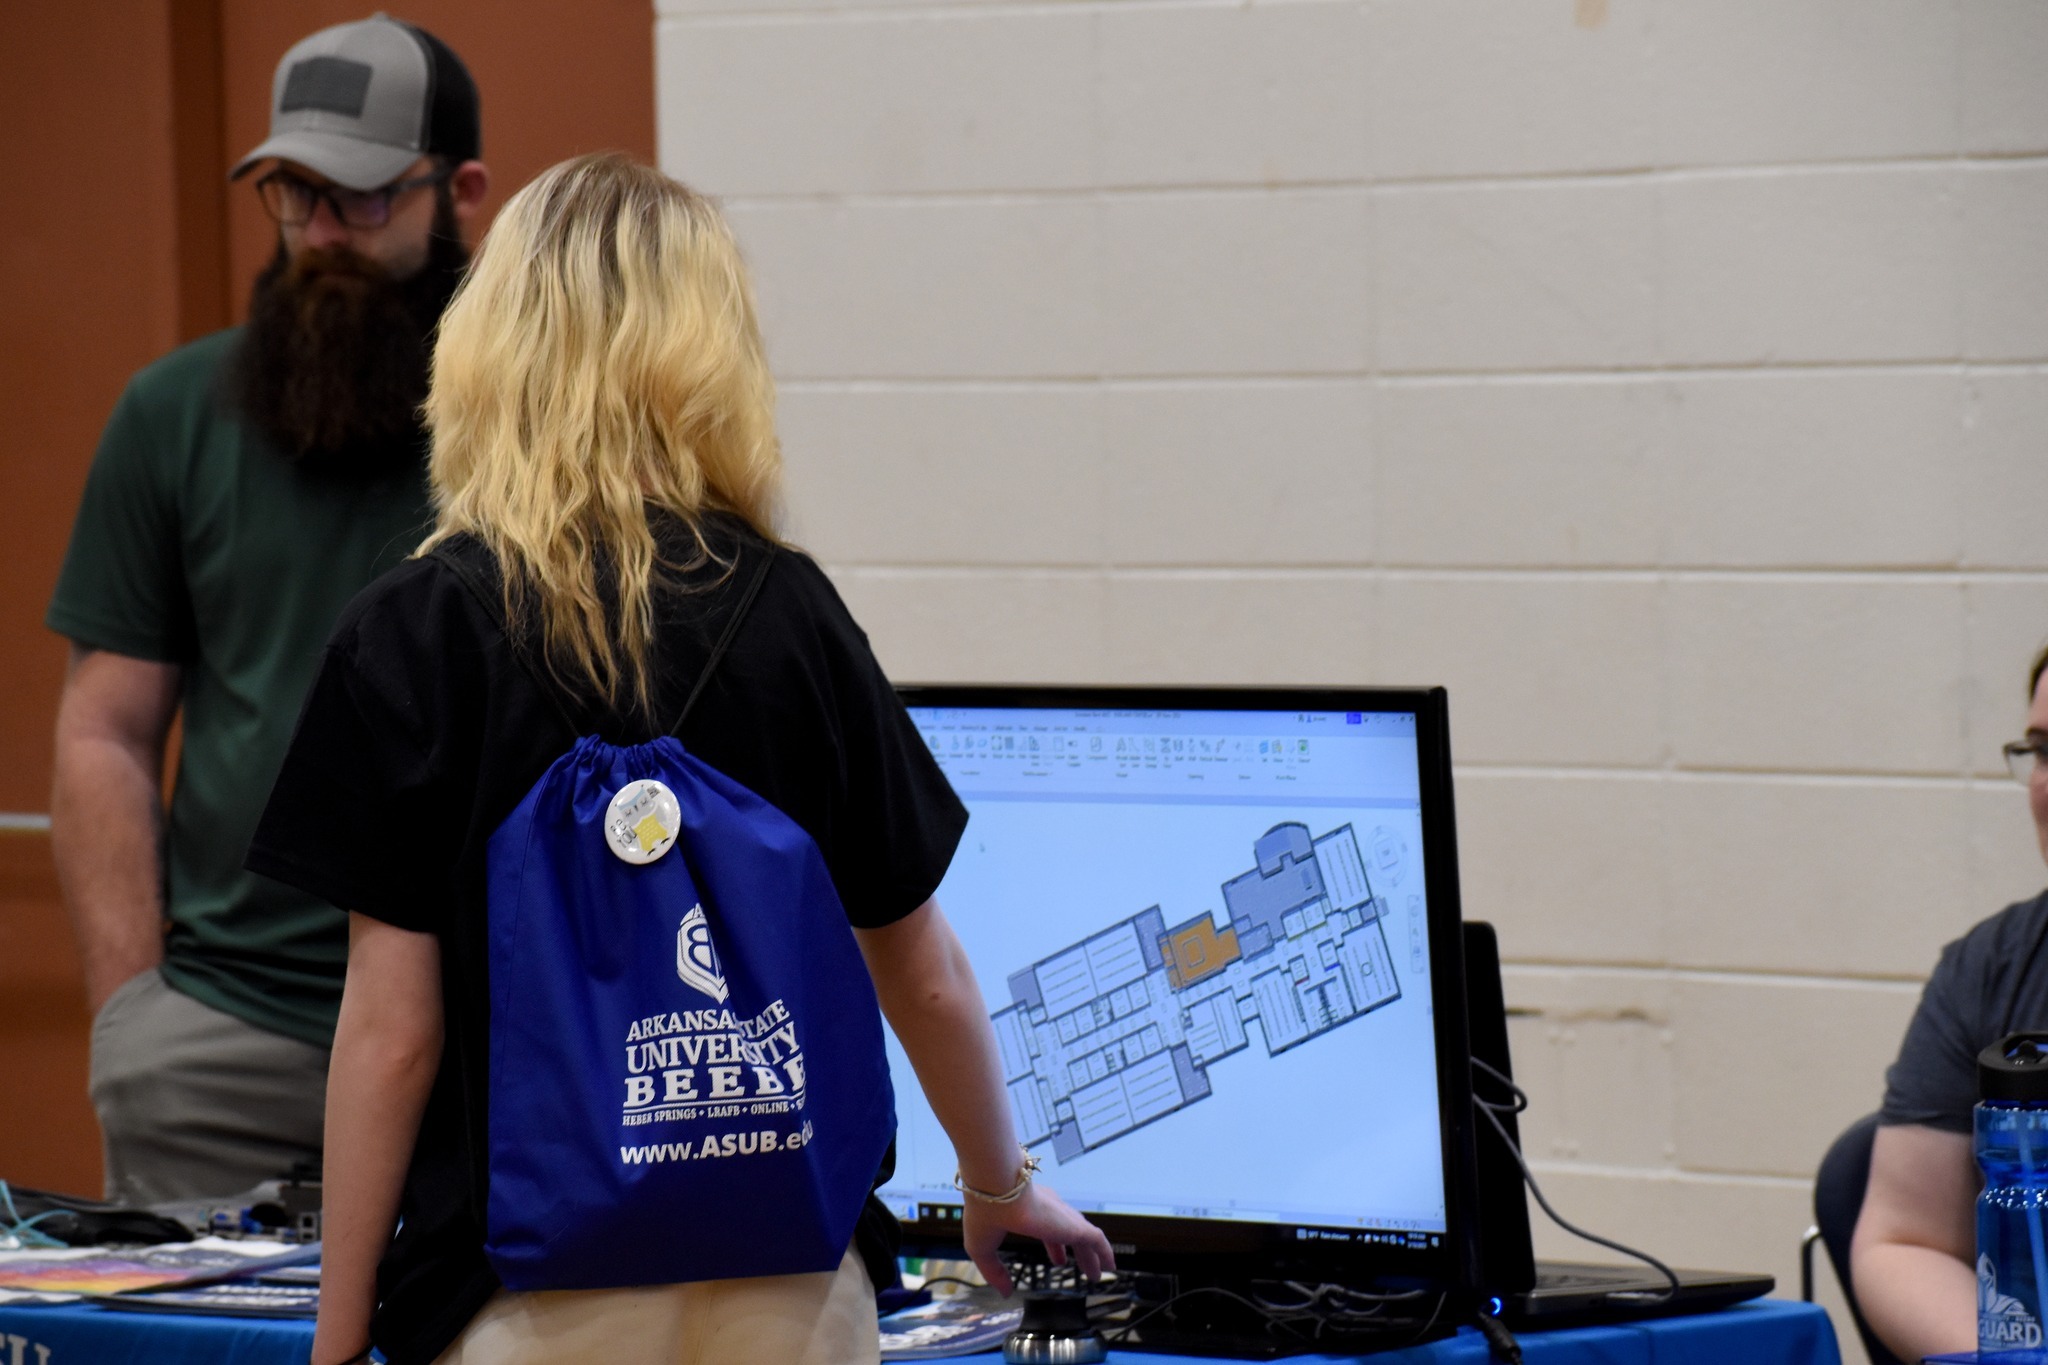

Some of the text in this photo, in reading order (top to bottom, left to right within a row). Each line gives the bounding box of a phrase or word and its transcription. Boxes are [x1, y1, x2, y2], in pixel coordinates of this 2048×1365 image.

[626, 1009, 740, 1043] ARKANSA
[622, 1112, 652, 1126] HEBER
[654, 1107, 697, 1122] SPRINGS
[751, 1100, 789, 1115] ONLINE
